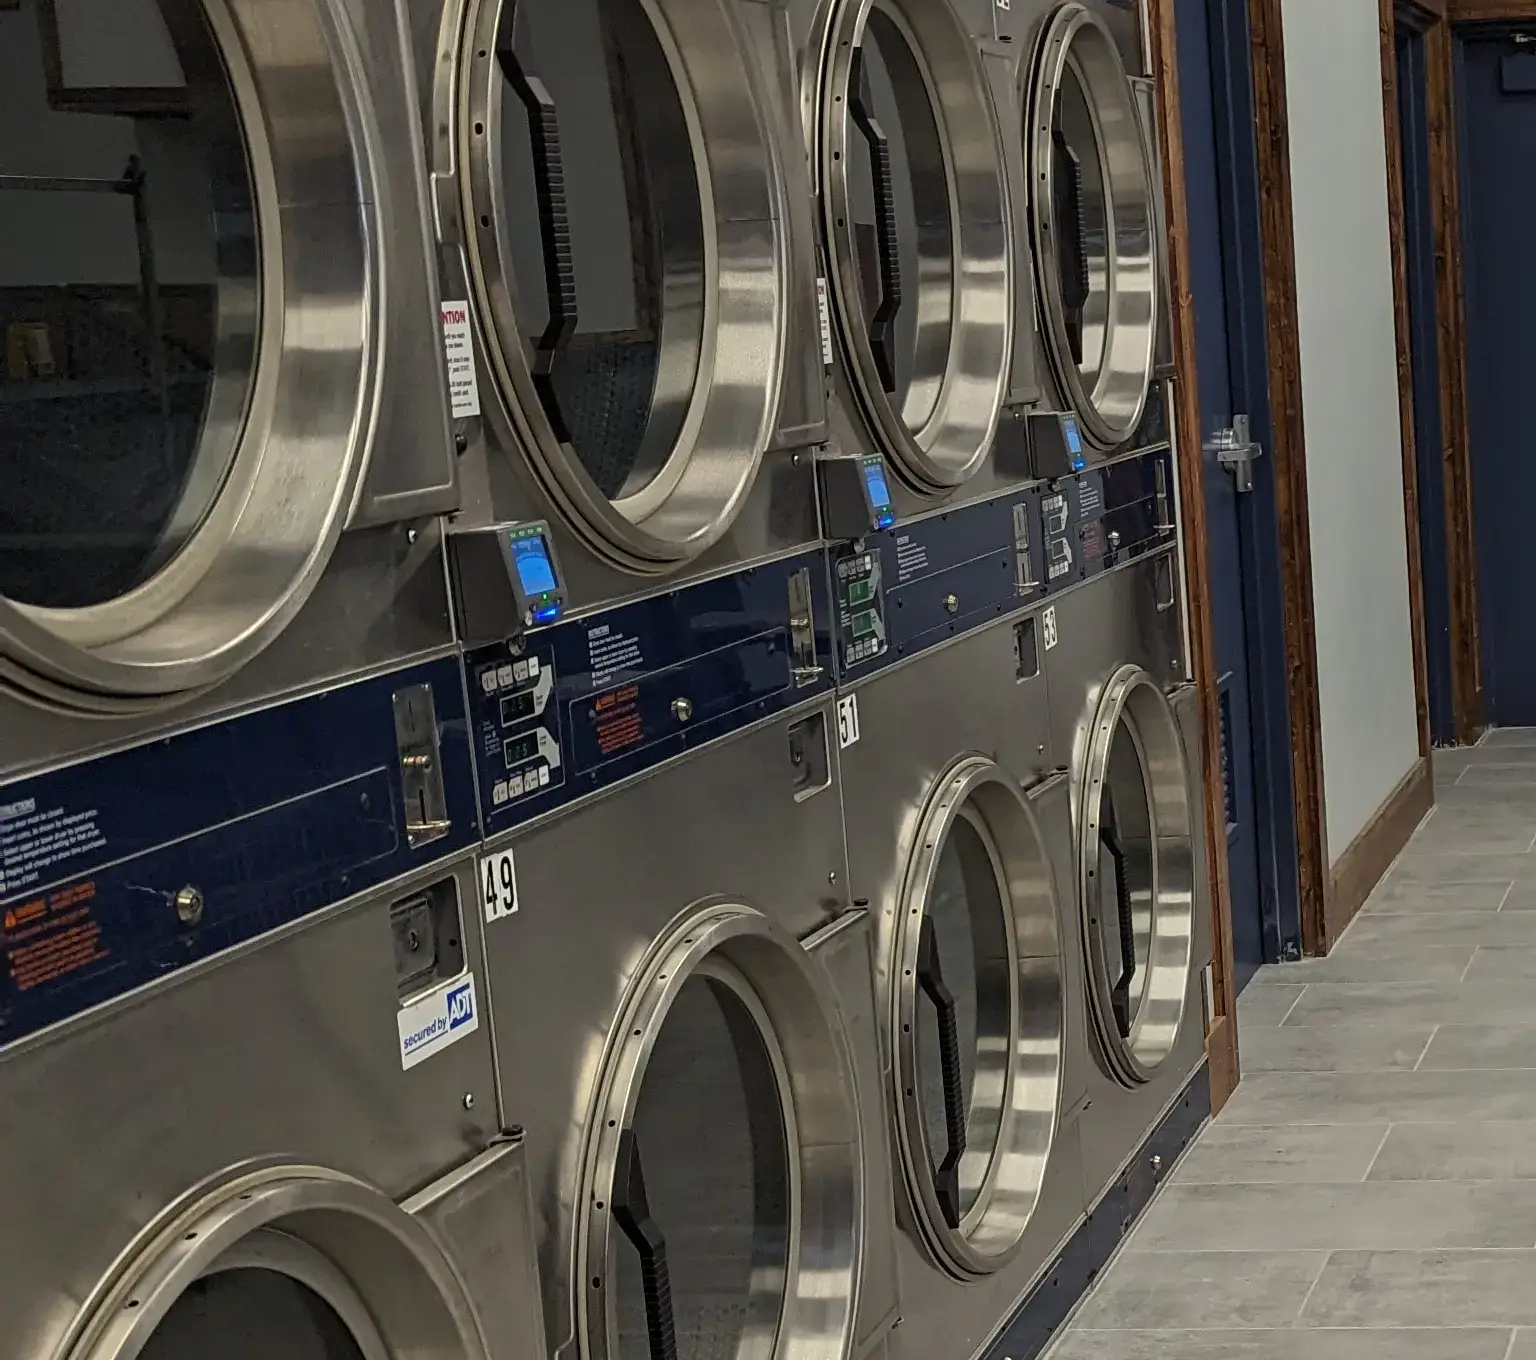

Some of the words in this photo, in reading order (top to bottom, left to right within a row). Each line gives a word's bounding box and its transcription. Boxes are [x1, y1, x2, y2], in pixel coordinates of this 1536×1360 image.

[839, 695, 857, 744] 51
[486, 855, 515, 916] 49
[403, 1019, 437, 1050] secured
[437, 1016, 448, 1031] by
[448, 989, 472, 1024] ADT
